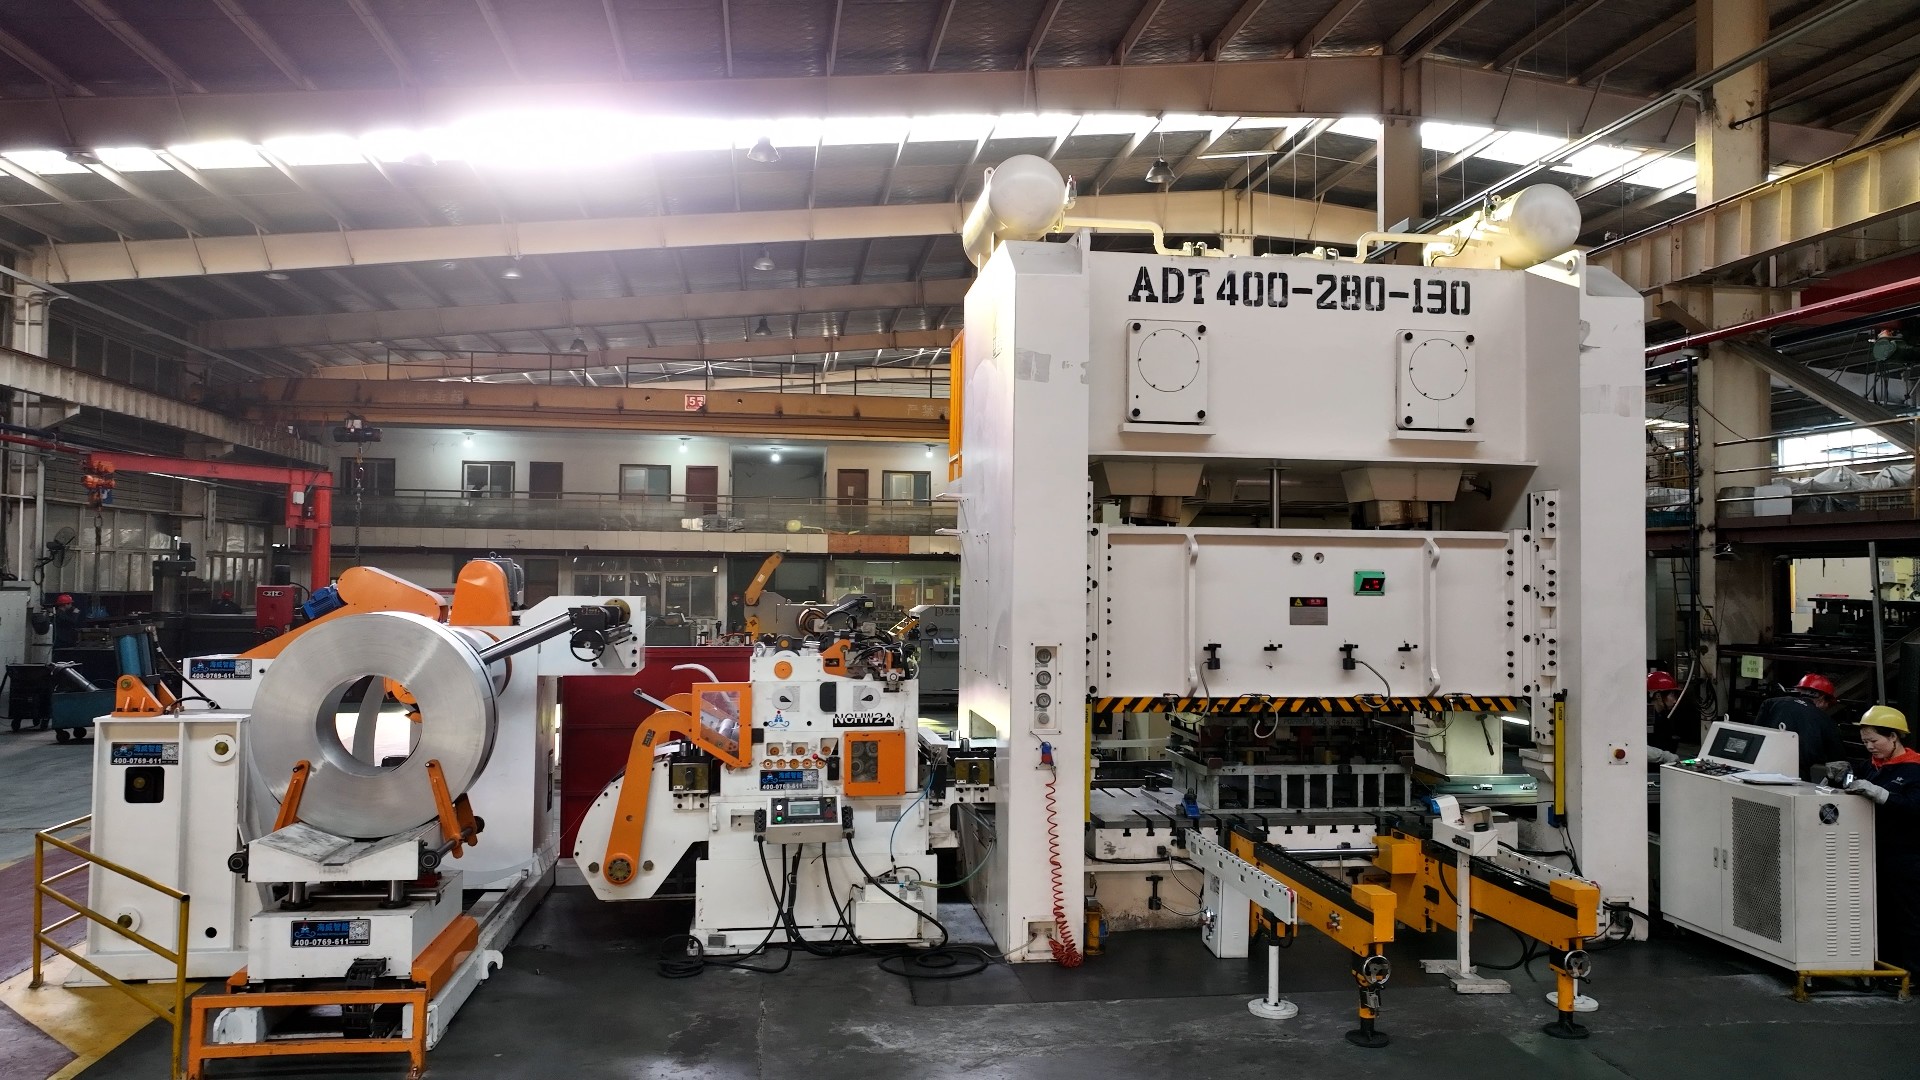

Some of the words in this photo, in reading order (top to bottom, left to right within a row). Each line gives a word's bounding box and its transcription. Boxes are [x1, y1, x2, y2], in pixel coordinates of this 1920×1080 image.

[1128, 266, 1210, 305] ADT
[1216, 270, 1471, 315] 400-280-130
[294, 938, 349, 946] 400-0769-611
